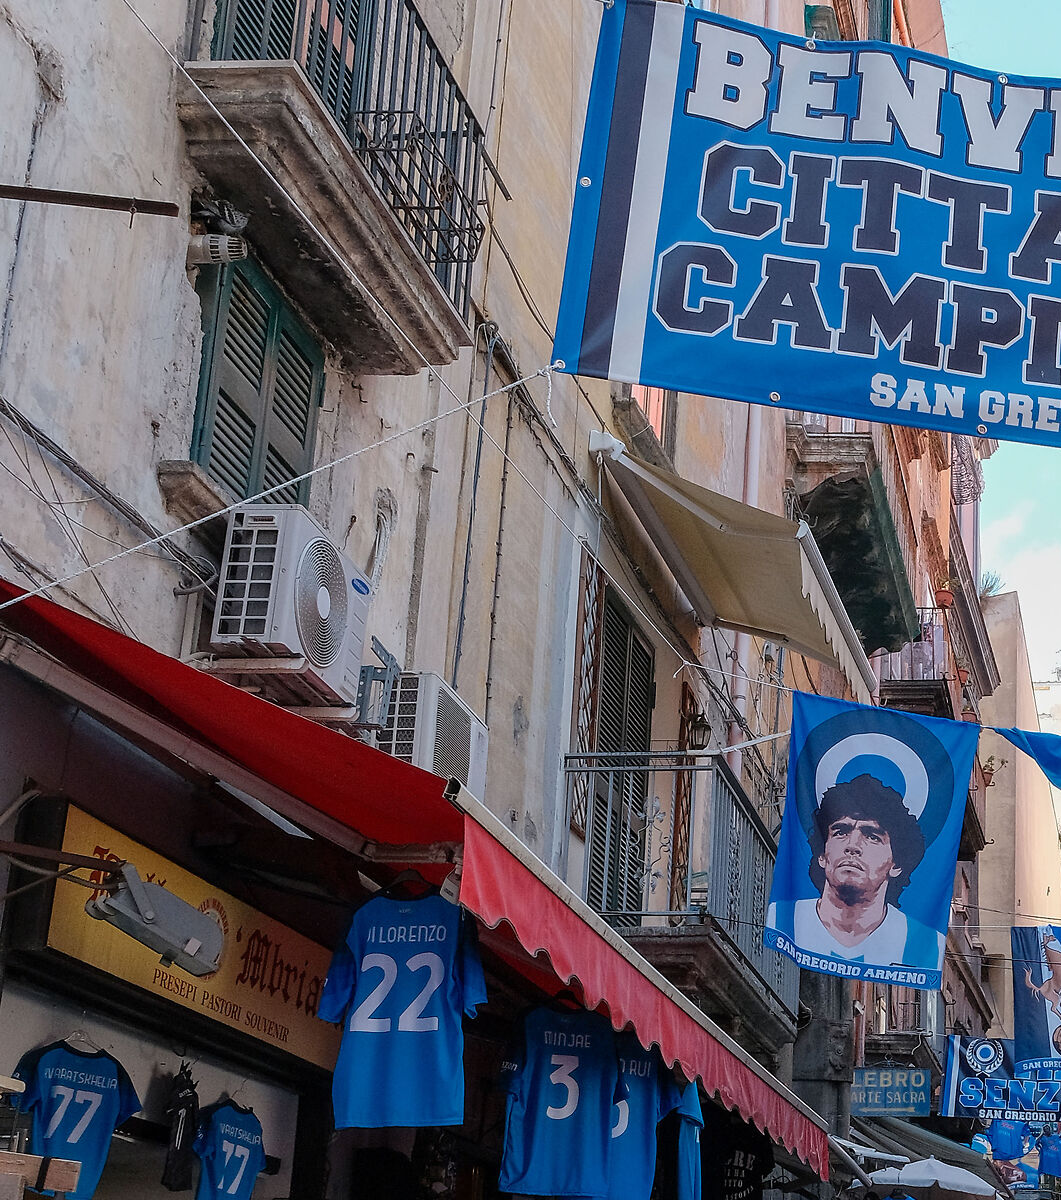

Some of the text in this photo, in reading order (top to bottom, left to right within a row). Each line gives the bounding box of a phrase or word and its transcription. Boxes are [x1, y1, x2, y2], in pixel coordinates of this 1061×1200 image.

[870, 373, 964, 420] SAN
[379, 925, 447, 944] LORENZO
[350, 952, 445, 1033] 22
[796, 952, 861, 976] GREGORIO
[864, 967, 926, 985] ARMENO
[153, 968, 290, 1043] PRESEPI PASTORI SOUVENIR
[546, 1054, 579, 1120] 3
[886, 1091, 926, 1104] SACRA
[44, 1085, 103, 1144] 77
[979, 1108, 1002, 1120] SAN
[1004, 1110, 1056, 1122] GREGORIO
[217, 1140, 250, 1195] 77
